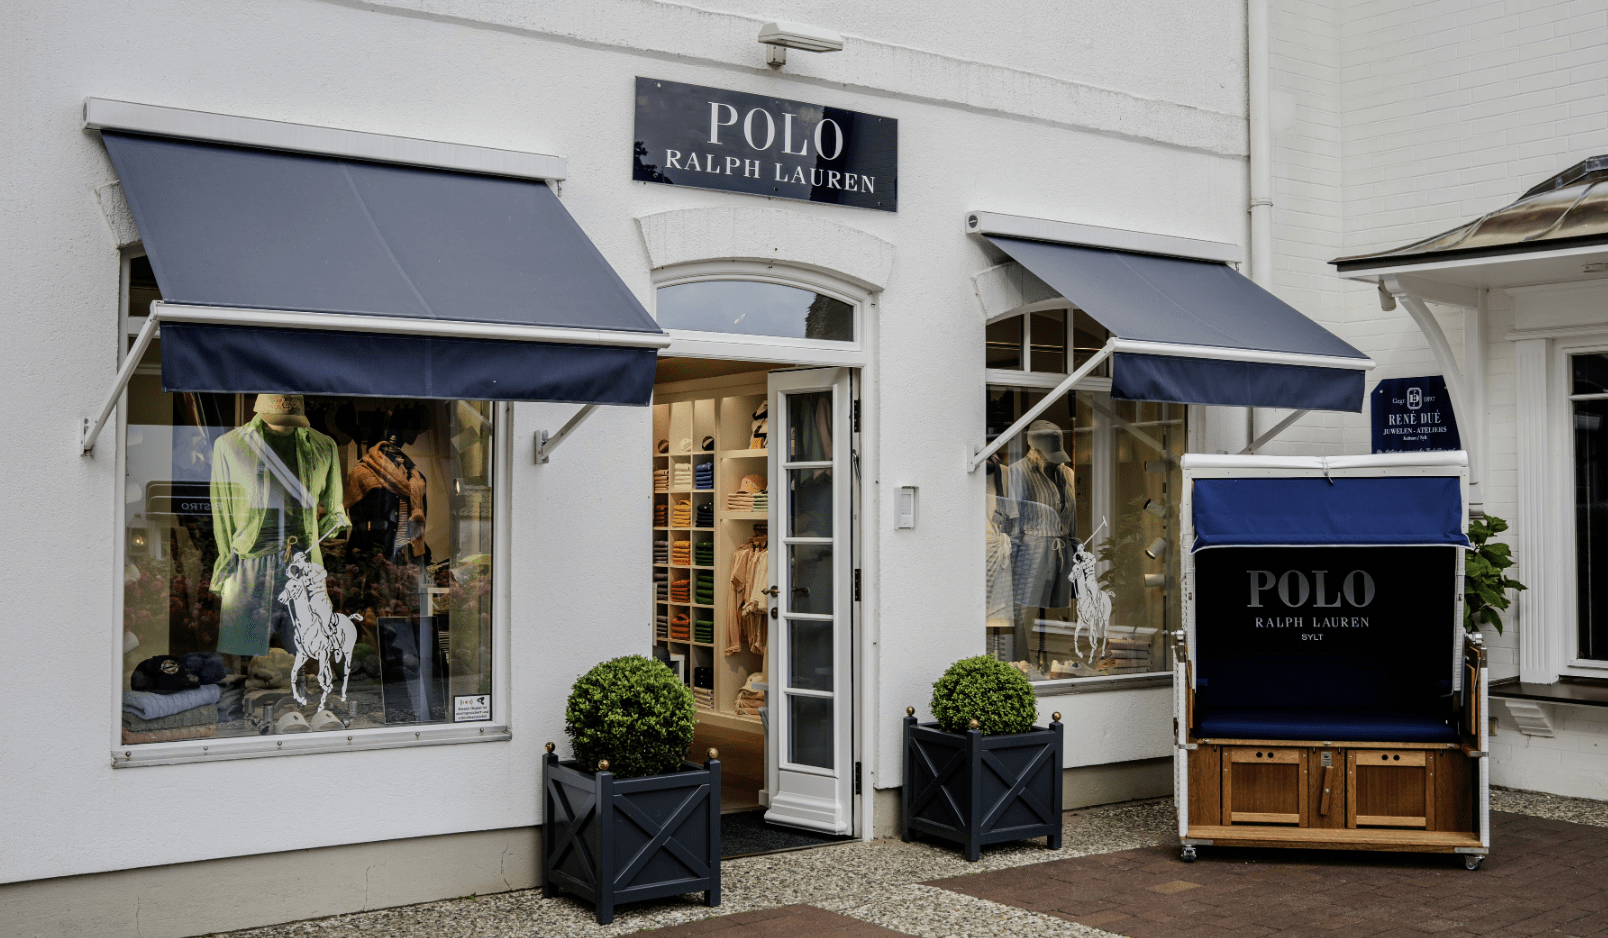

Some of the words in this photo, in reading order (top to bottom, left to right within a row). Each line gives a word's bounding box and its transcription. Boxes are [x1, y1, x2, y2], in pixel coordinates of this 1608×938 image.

[707, 101, 843, 160] POLO
[665, 149, 761, 179] RALPH
[774, 162, 876, 194] LAUREN
[1388, 410, 1417, 425] RENÉ
[1420, 409, 1441, 424] DUÉ
[1246, 569, 1376, 608] POLO
[1255, 617, 1303, 628] RALPH
[1312, 617, 1369, 628] LAUREN
[1301, 633, 1324, 641] SYLT
